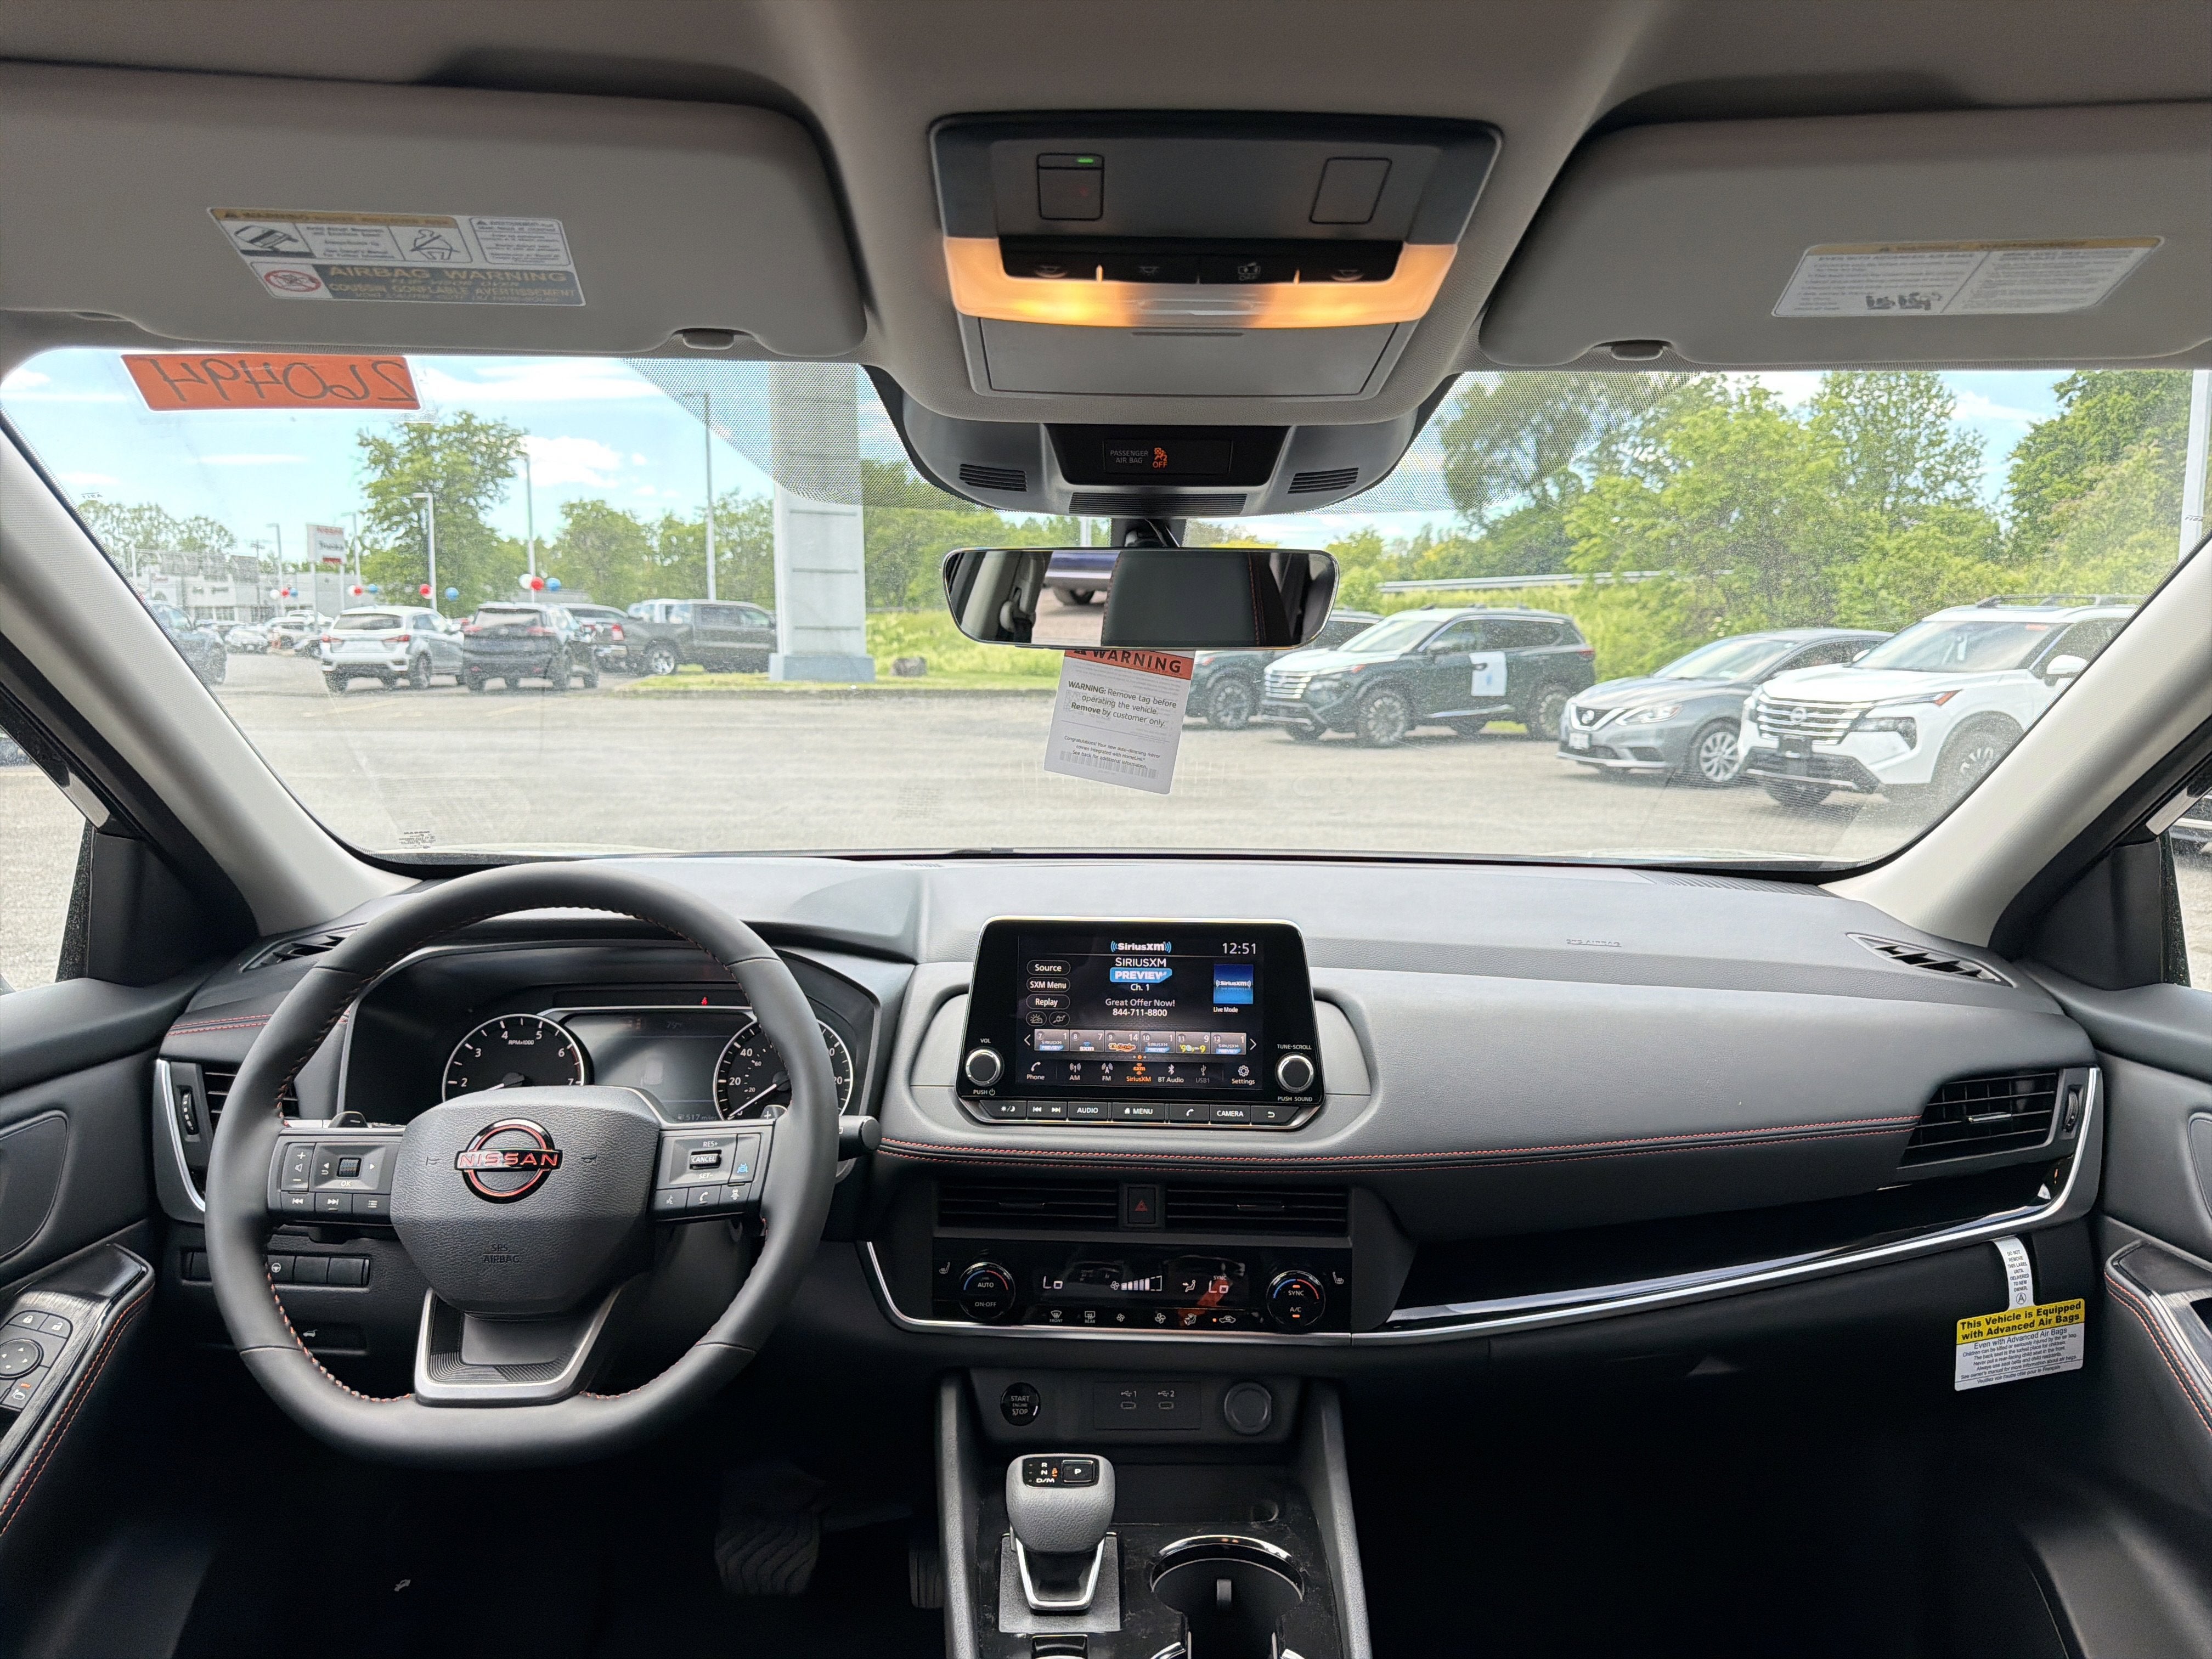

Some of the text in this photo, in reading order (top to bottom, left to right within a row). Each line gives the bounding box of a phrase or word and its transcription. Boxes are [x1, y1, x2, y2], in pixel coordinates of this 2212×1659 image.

[330, 266, 567, 282] AIRBAG WARNING
[1093, 649, 1182, 674] WARNING
[1068, 680, 1177, 708] WARNING: Remove tag before
[1081, 695, 1158, 715] operating the vehicle.
[1071, 702, 1165, 728] Remove by customer only.
[1064, 736, 1097, 746] Congratulations!
[1118, 747, 1147, 757] auto-dimming
[1090, 747, 1111, 755] integrated
[1222, 943, 1256, 955] 12:51
[1115, 957, 1166, 967] SIRIUSXM
[1115, 970, 1167, 979] PREVIEW
[1035, 998, 1058, 1007] Replay
[1105, 998, 1128, 1007] Great
[1130, 998, 1152, 1007] Offer
[501, 1030, 509, 1040] 4
[536, 1031, 542, 1040] 5
[475, 1048, 481, 1058] 3
[558, 1048, 565, 1057] 6
[741, 1048, 753, 1057] 40
[461, 1077, 468, 1087] 2
[729, 1077, 741, 1086] 20
[460, 1153, 558, 1167] NISSAN
[483, 1255, 520, 1263] AIRBAG
[2018, 1294, 2024, 1302] A
[1960, 1319, 1982, 1330] This
[1985, 1313, 2021, 1325] Vehicle
[2036, 1301, 2081, 1317] Equipped
[1961, 1314, 2080, 1340] with Advanced Air Bags
[2007, 1332, 2039, 1344] Advanced
[2051, 1328, 2067, 1337] Bags
